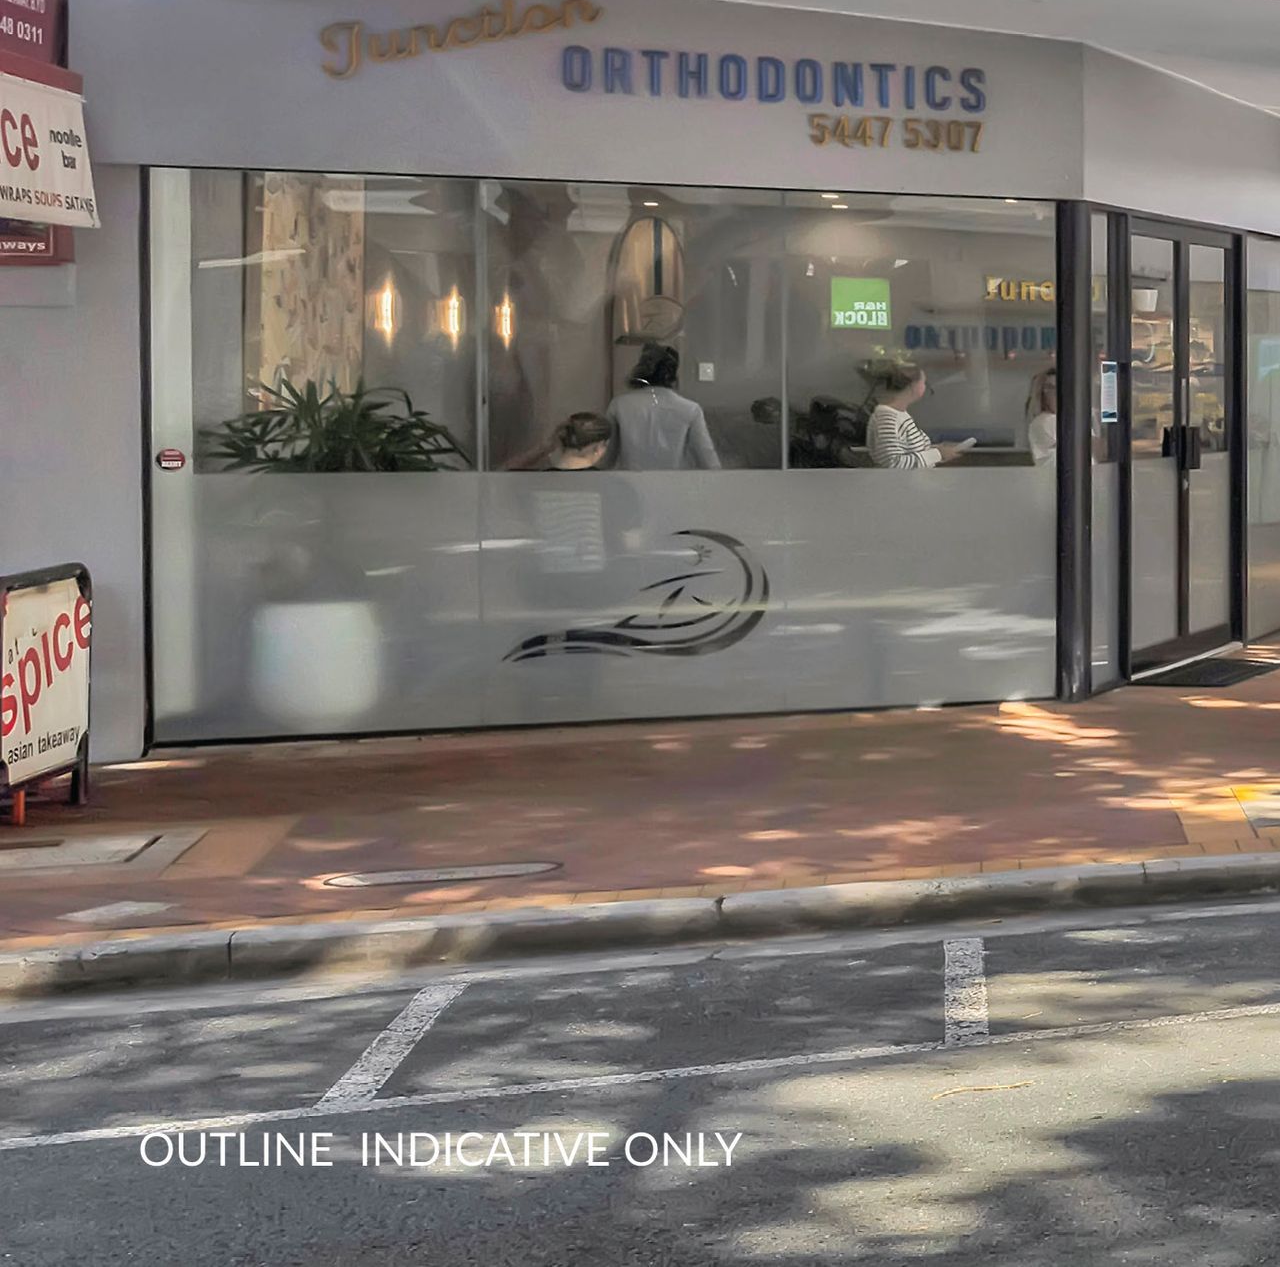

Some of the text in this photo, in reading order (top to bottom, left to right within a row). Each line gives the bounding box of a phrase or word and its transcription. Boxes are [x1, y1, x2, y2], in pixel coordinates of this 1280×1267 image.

[17, 21, 43, 45] 0311
[562, 44, 988, 114] ORTHODONTICS
[808, 114, 988, 153] 5447 5307
[61, 150, 77, 169] bar
[34, 190, 64, 208] SOUPS
[0, 240, 47, 253] ways
[0, 595, 90, 739] spice
[8, 724, 81, 765] asian takeaway
